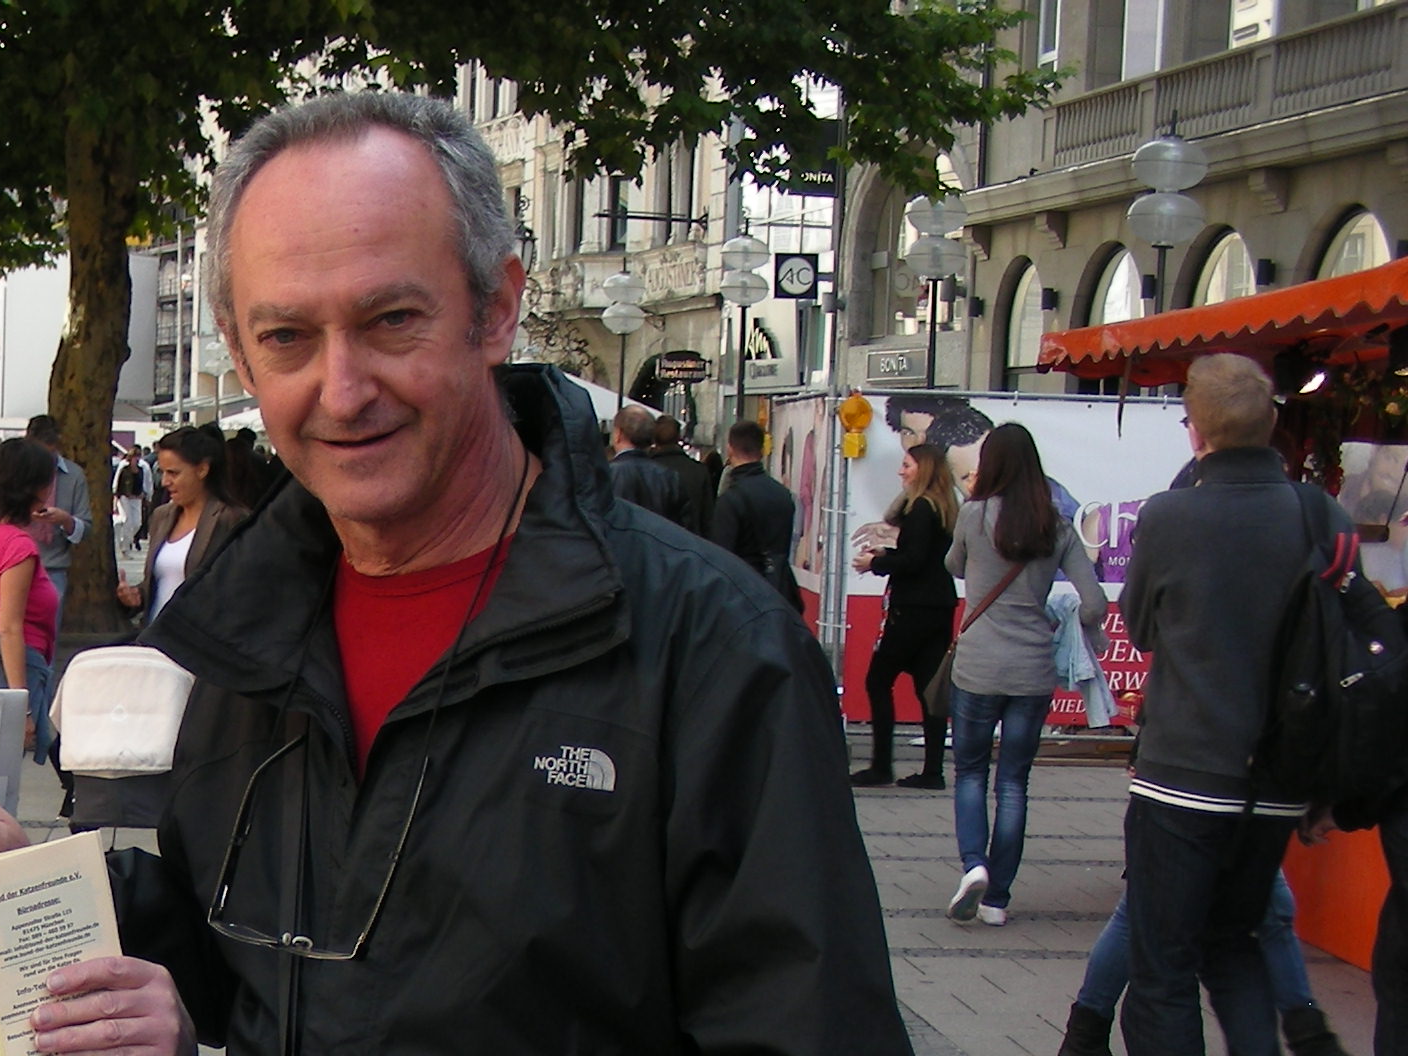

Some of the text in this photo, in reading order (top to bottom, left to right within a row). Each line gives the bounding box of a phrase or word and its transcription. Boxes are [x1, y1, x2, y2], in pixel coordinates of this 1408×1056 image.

[560, 745, 591, 761] THE
[534, 756, 588, 775] NORTH
[547, 771, 586, 788] FACE
[6, 891, 17, 899] der
